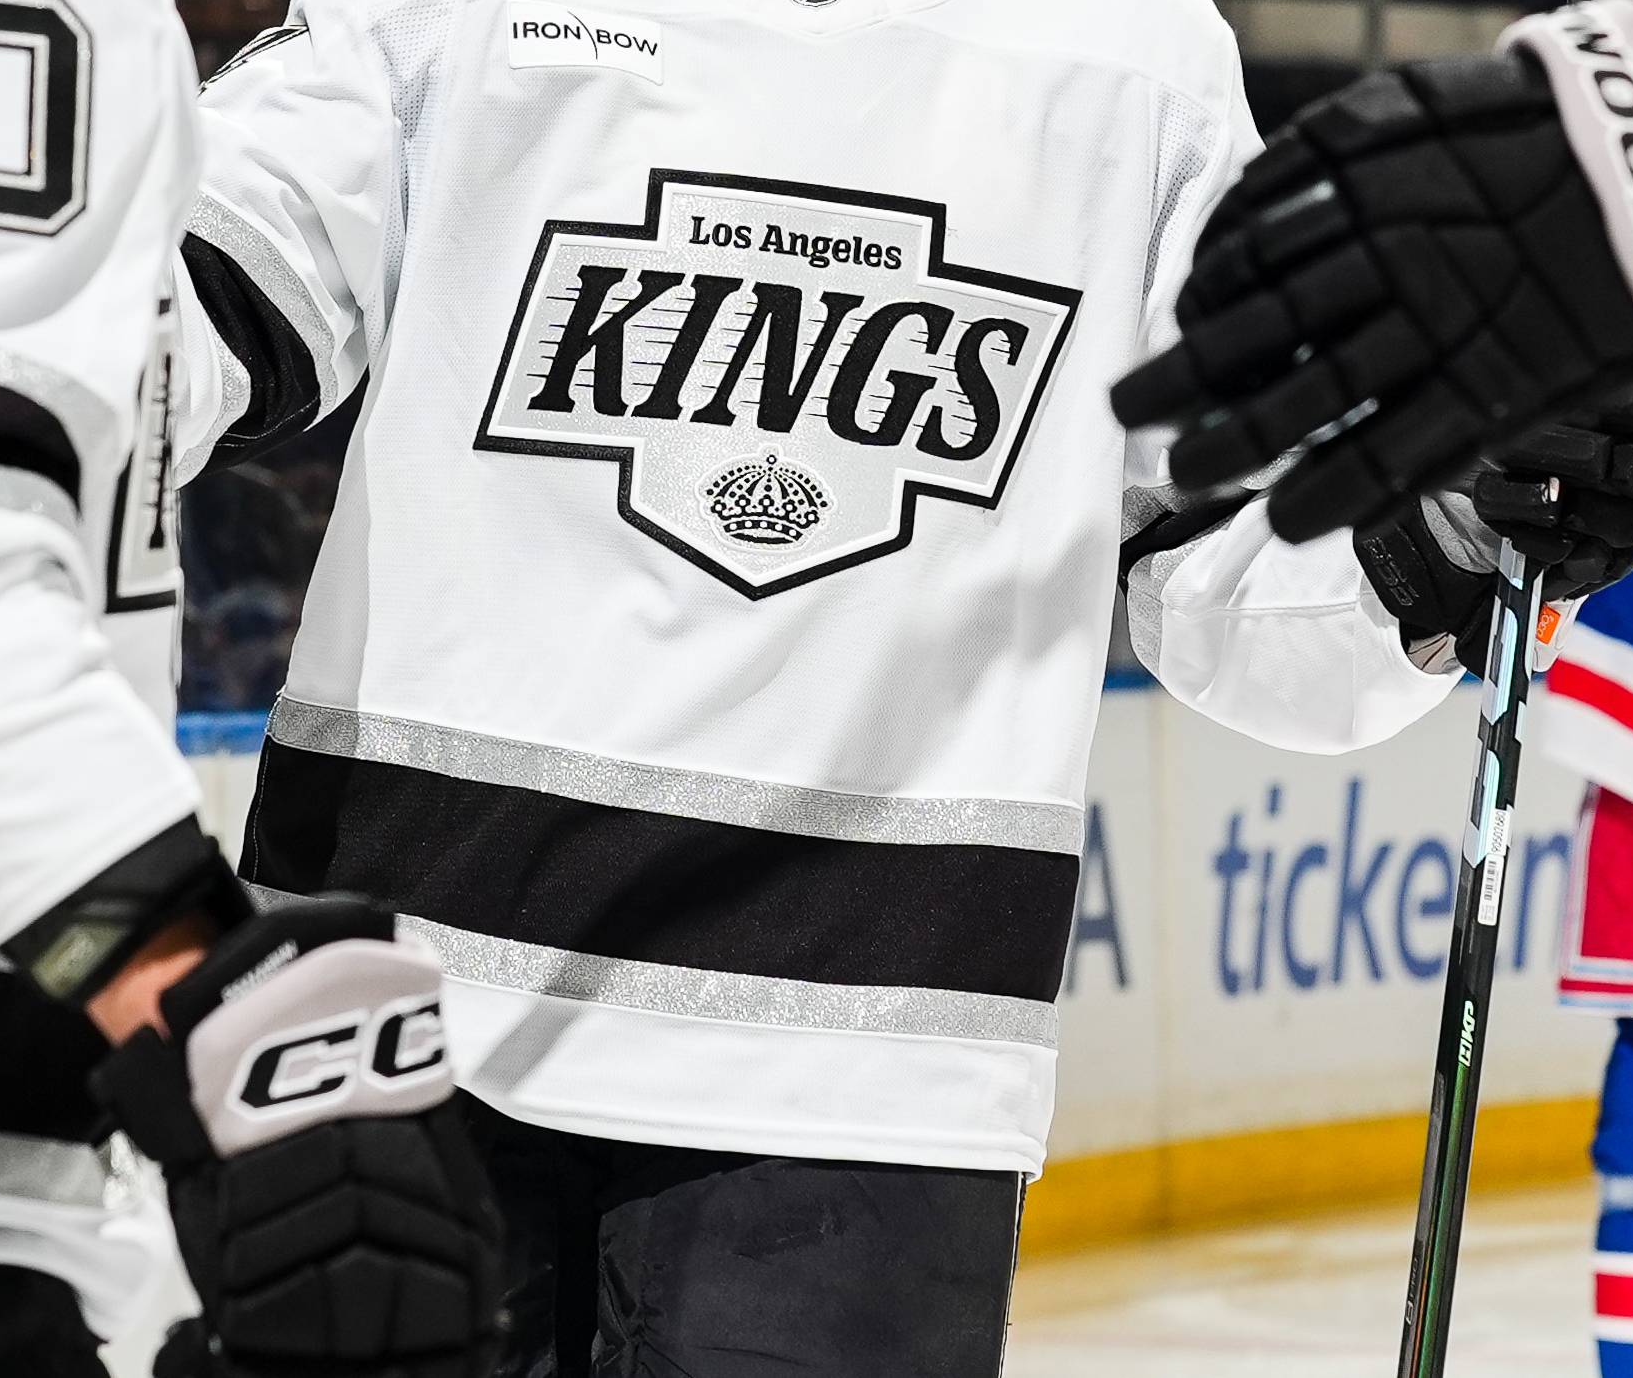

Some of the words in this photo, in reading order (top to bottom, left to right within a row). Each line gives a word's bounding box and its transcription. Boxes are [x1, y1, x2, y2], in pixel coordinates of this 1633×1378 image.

[512, 20, 582, 40] IRON
[597, 28, 659, 57] BOW
[688, 215, 752, 251] Los
[758, 223, 903, 271] Angeles
[526, 263, 1031, 462] KINGS
[239, 1000, 446, 1110] CC
